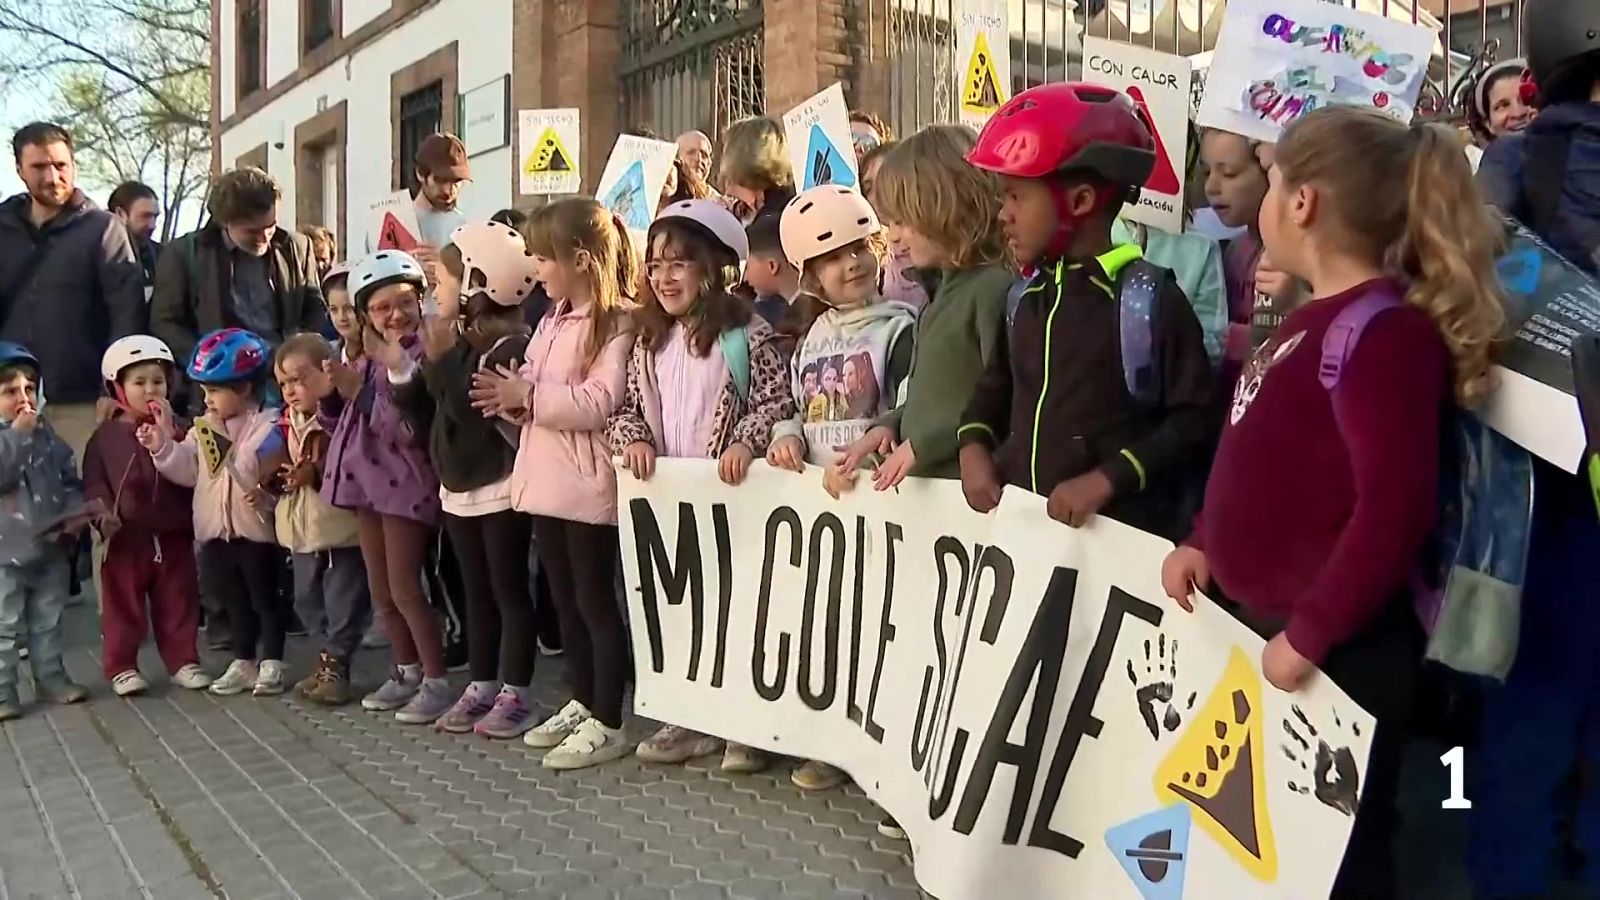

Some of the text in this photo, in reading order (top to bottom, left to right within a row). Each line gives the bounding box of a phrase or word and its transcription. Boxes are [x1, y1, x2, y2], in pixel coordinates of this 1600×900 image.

[962, 13, 1001, 28] SIN TECHO
[1089, 55, 1178, 89] CON CALOR
[630, 497, 732, 688] MI
[752, 505, 904, 744] COLE
